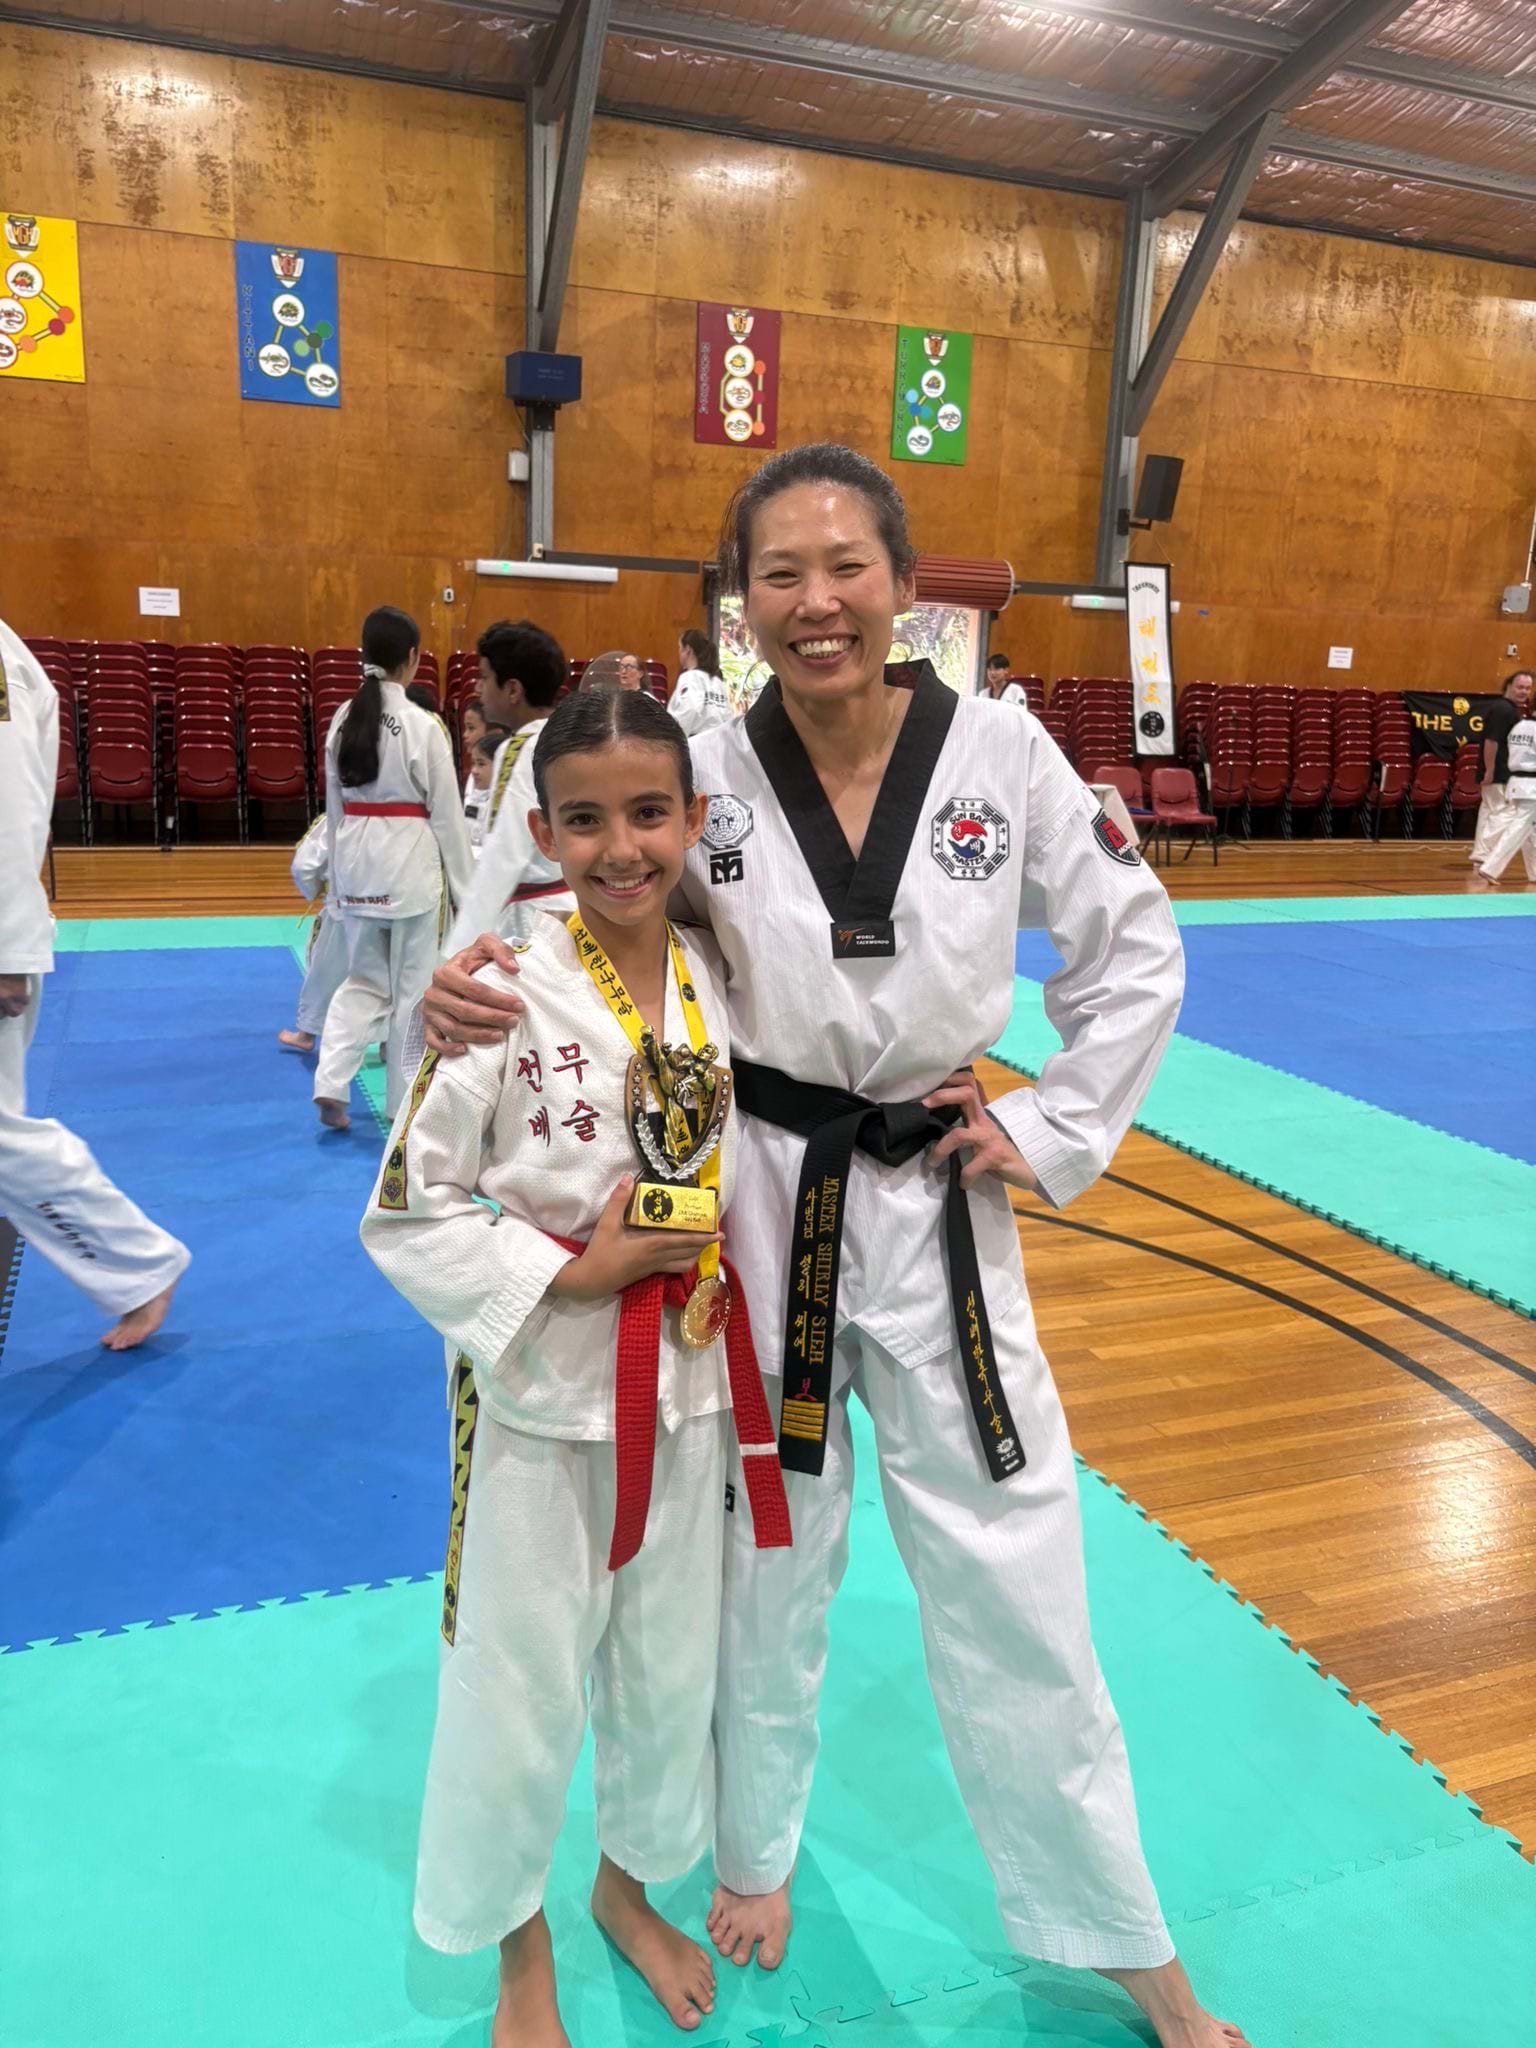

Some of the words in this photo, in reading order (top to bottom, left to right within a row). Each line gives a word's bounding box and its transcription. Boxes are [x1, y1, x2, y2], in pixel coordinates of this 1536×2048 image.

[1411, 711, 1454, 732] THE
[949, 811, 968, 825] SUN
[969, 812, 989, 826] BAE
[951, 853, 987, 867] MASTER
[819, 1174, 840, 1233] MASTER
[813, 1242, 833, 1309] SHIRLY
[809, 1315, 827, 1365] SIEH
